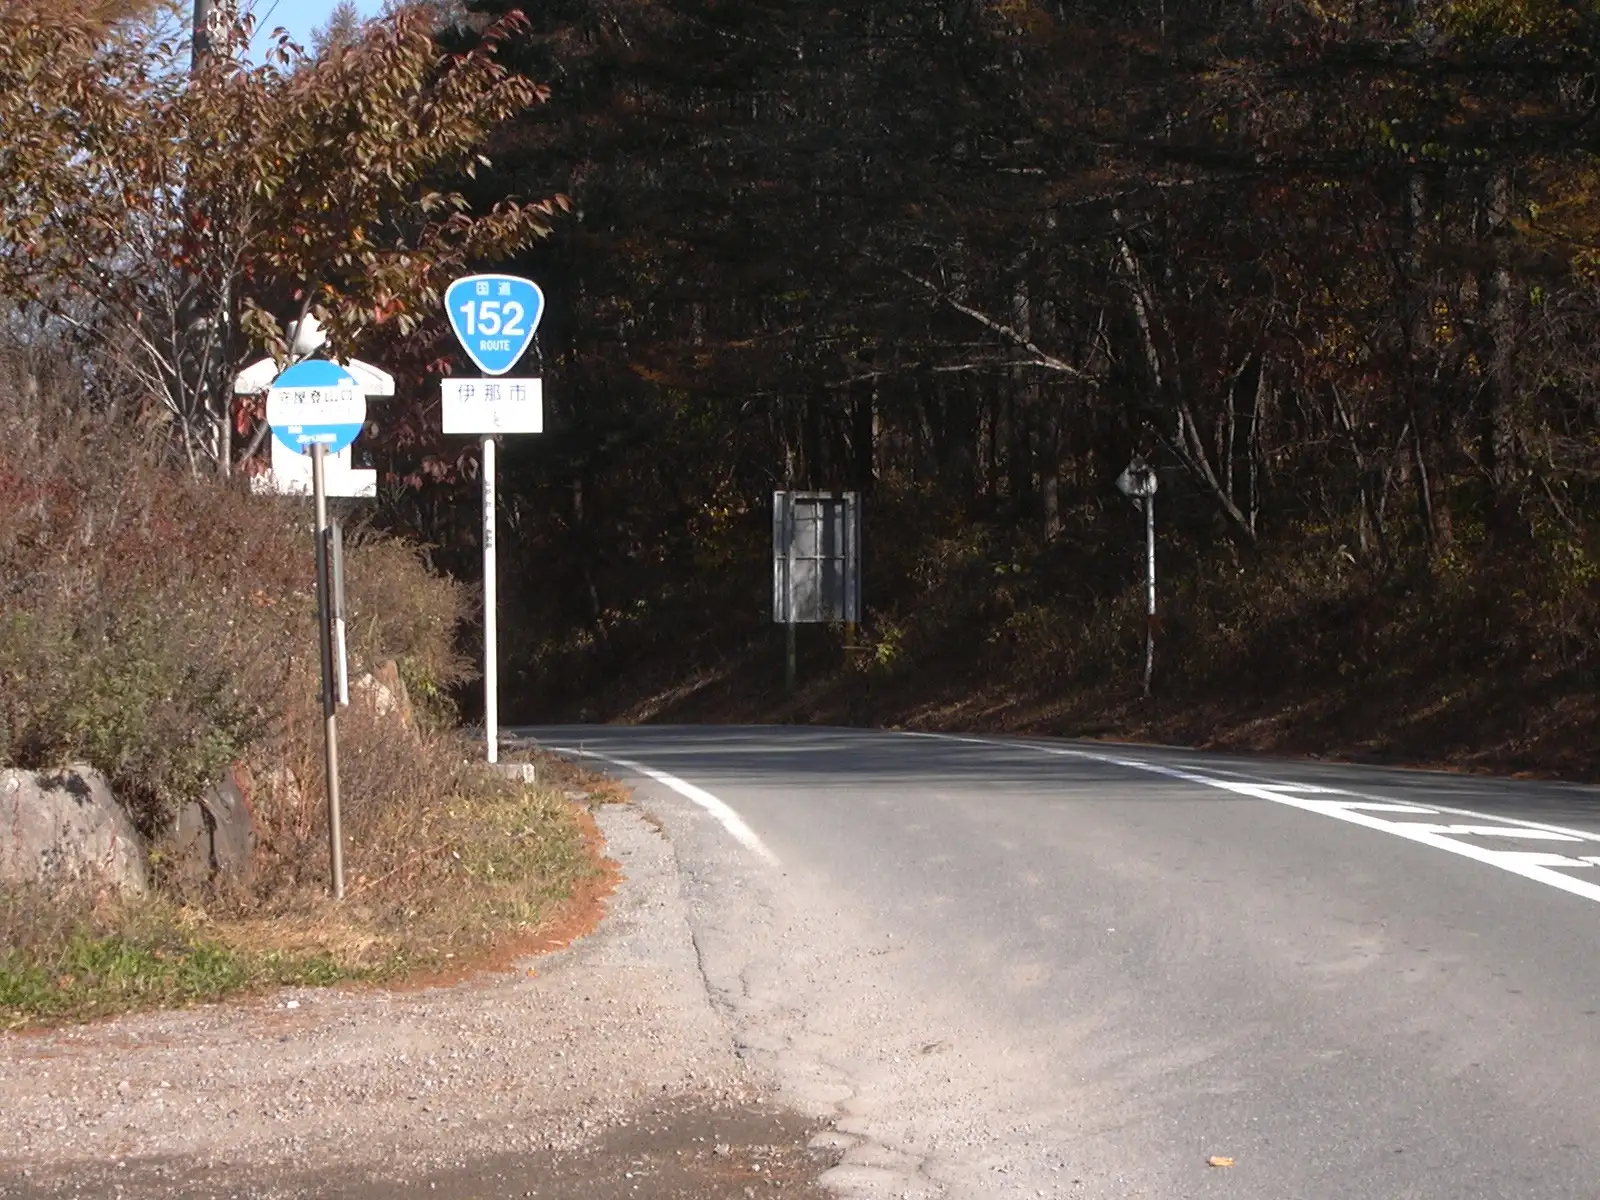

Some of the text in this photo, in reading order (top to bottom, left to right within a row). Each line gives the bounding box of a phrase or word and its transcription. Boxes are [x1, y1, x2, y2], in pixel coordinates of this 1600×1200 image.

[475, 281, 512, 296] 国道
[460, 300, 525, 336] 152
[480, 340, 511, 351] ROUTE
[457, 384, 527, 403] 伊那市
